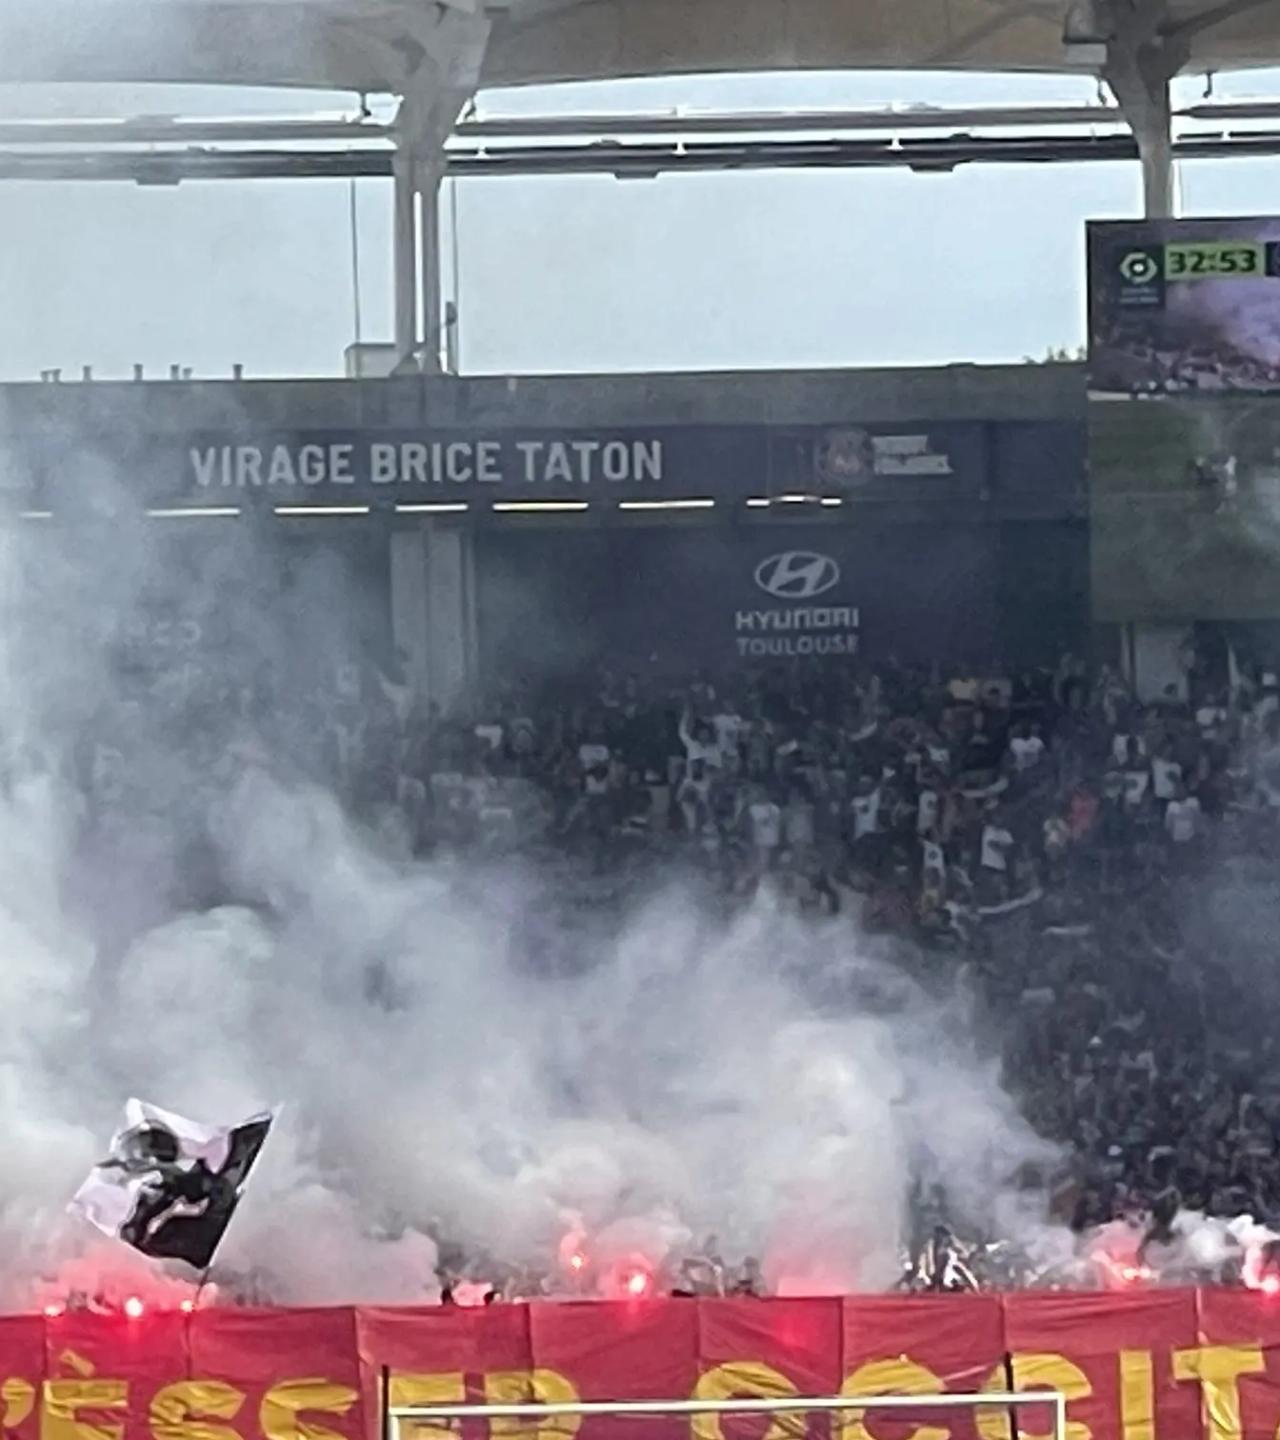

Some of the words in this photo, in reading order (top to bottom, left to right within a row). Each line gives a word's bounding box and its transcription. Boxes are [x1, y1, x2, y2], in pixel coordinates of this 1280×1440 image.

[1169, 249, 1257, 274] 32:53
[189, 443, 355, 486] VIRAGE
[369, 441, 502, 482] BRICE
[515, 439, 663, 481] TATON
[734, 606, 860, 631] HYUNDAI
[734, 634, 860, 657] TOULOUSE
